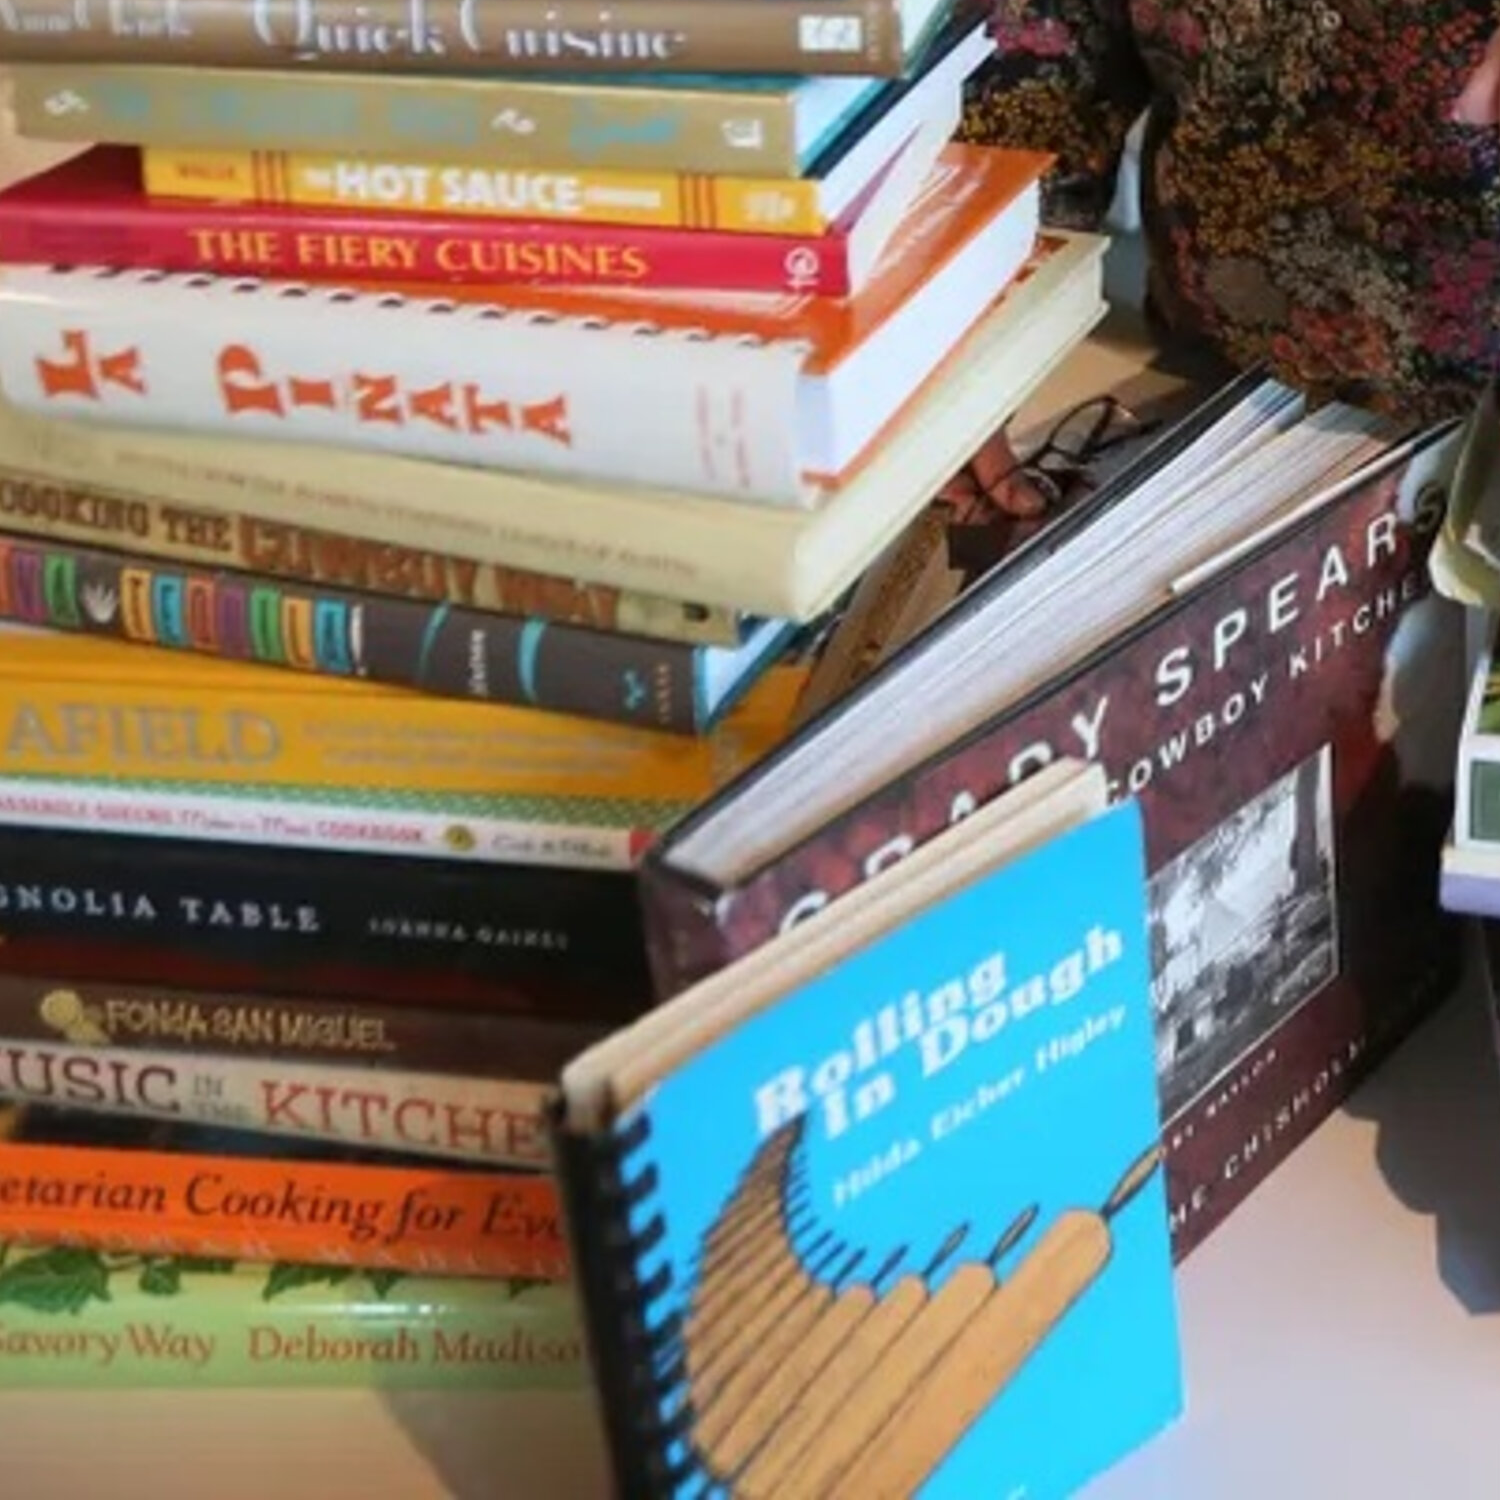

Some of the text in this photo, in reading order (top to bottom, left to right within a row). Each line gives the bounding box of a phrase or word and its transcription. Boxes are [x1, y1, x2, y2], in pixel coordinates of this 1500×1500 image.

[336, 161, 431, 204] HOT
[439, 168, 581, 212] SAUCE
[190, 229, 648, 278] THE FIERY CUISINES
[35, 331, 147, 399] LA
[158, 505, 232, 552] THE
[1103, 572, 1416, 809] COWBOY KITCHE
[5, 703, 283, 767] AFIELD
[179, 897, 321, 932] TABLE
[368, 917, 468, 943] JOANNA
[474, 928, 569, 951] GAINES
[106, 999, 386, 1049] FONDA SAN MIGUEL
[753, 950, 1007, 1138] Rolling
[820, 924, 1123, 1141] In Dough
[0, 1050, 181, 1114] USIC
[260, 1080, 552, 1160] KITCHE
[0, 1170, 167, 1213] etarian
[184, 1172, 386, 1245] Cooking
[381, 1188, 464, 1246] for
[126, 1322, 216, 1367] Way
[247, 1323, 419, 1364] Deborah
